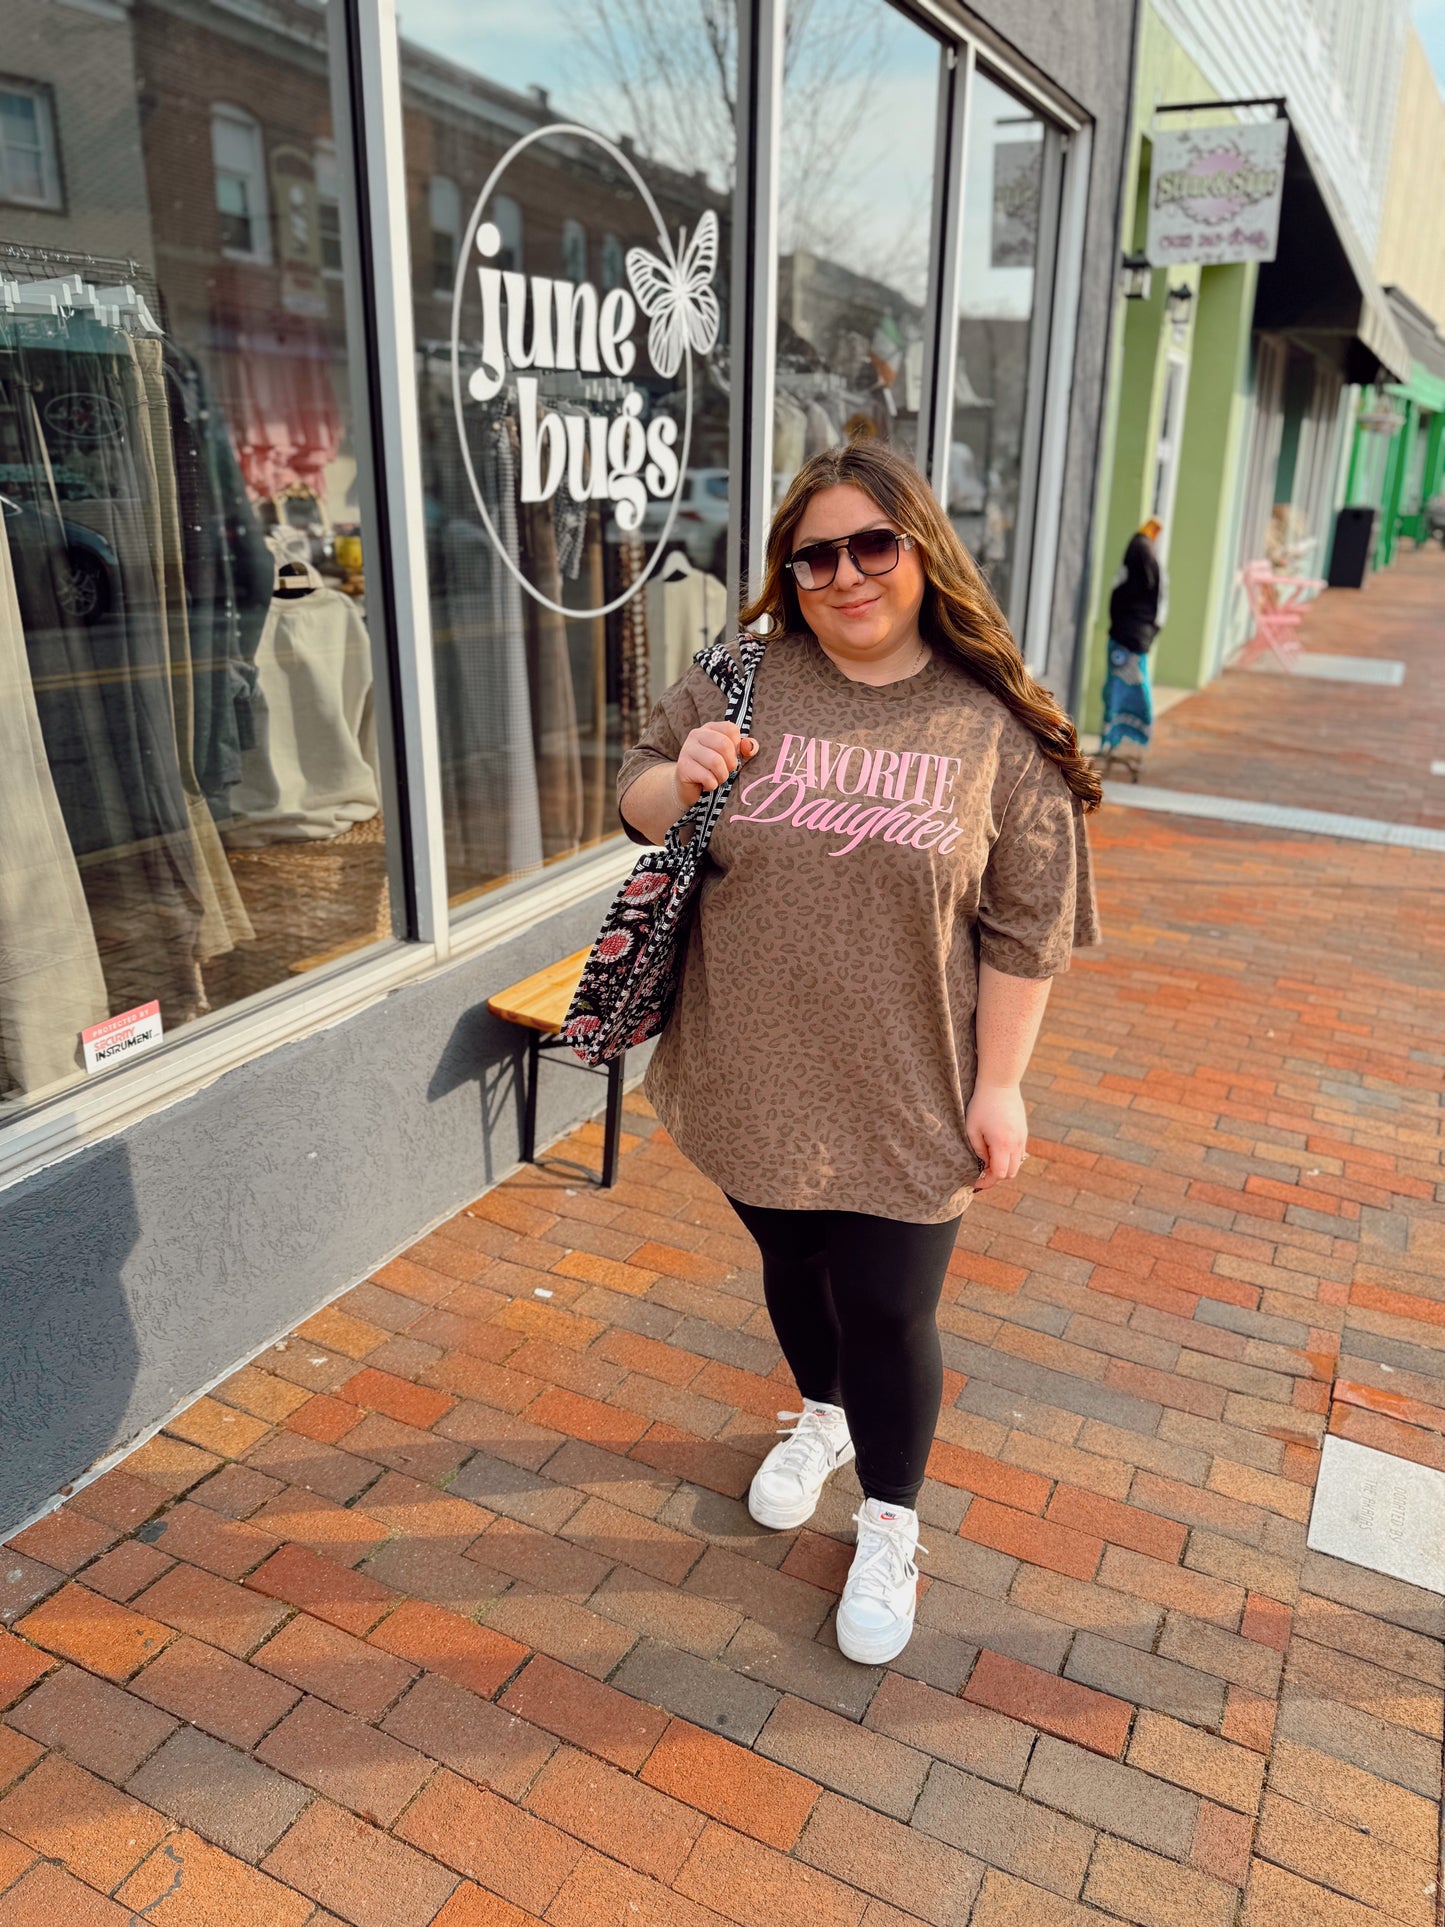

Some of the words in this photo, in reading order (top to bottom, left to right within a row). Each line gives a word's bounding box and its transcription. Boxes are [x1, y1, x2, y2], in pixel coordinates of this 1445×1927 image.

[468, 222, 636, 401] june
[516, 376, 679, 532] bugs
[769, 733, 962, 814] FAVORITE
[729, 772, 964, 857] Daughter
[92, 1014, 137, 1038] PROTECTED
[140, 1009, 149, 1018] BY
[94, 1026, 135, 1052] SECURITY
[95, 1029, 153, 1062] INSTRUMENT
[1363, 1479, 1378, 1496] THE
[1390, 1487, 1407, 1527] DONATED
